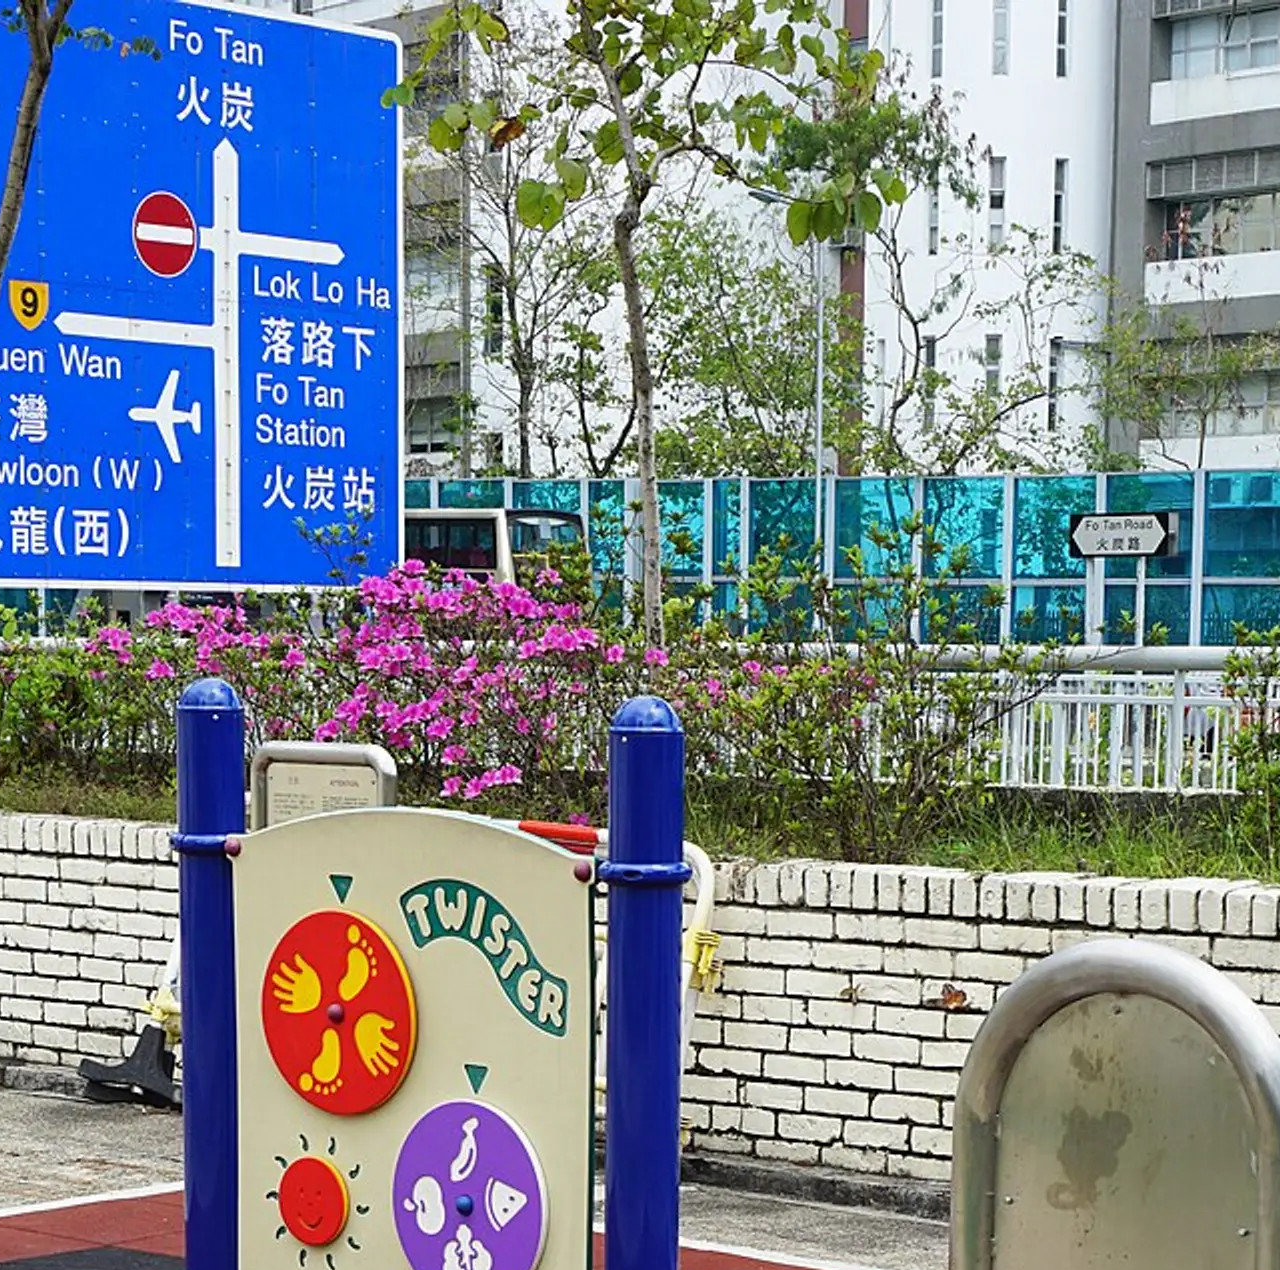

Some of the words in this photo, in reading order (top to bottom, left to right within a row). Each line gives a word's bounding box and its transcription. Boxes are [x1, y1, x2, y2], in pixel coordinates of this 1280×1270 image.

[169, 18, 203, 55] Fo
[214, 26, 263, 66] Tan
[176, 75, 254, 132] 火炭
[20, 286, 39, 318] 9
[253, 264, 302, 301] Lok
[312, 271, 344, 303] Lo
[356, 275, 391, 309] Ha
[58, 343, 122, 379] Wan
[260, 316, 376, 371] 落路下
[255, 372, 289, 405] Fo
[297, 375, 345, 409] Tan
[256, 413, 346, 448] Station
[262, 464, 376, 513] 火炭站
[1085, 520, 1099, 531] Fo
[1103, 519, 1122, 531] Tan
[1124, 519, 1153, 530] Road
[406, 887, 564, 1028] TWISTER
